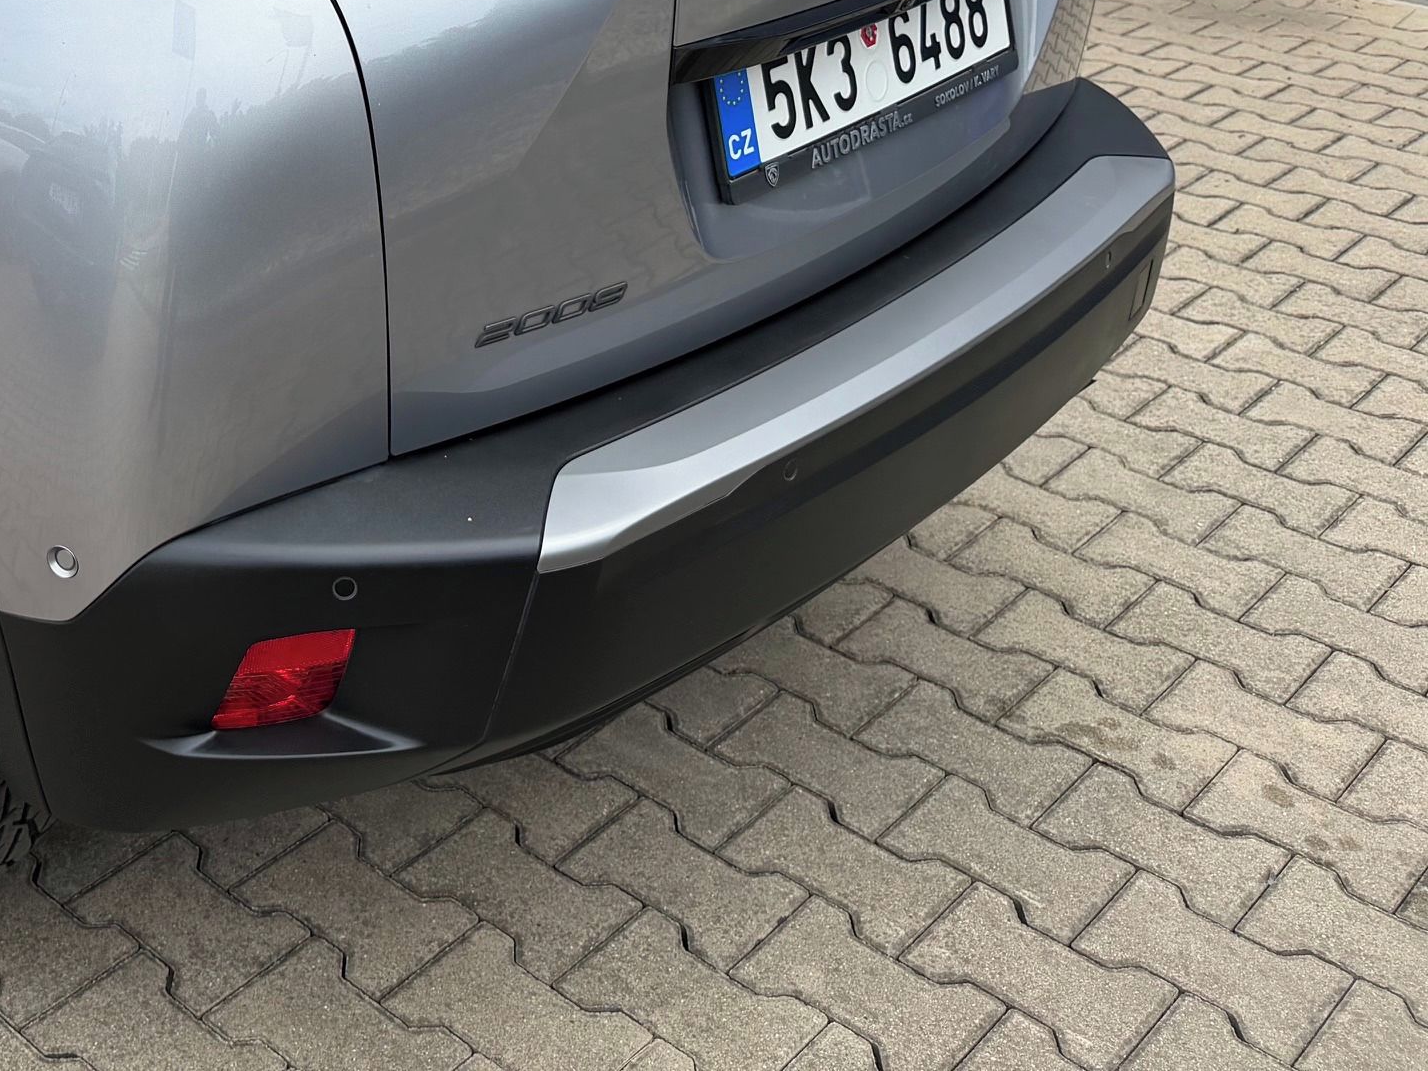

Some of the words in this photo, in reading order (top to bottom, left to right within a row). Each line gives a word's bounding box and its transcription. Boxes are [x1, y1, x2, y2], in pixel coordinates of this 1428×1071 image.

[760, 33, 859, 140] 5K3
[935, 80, 970, 107] SOKOLOV
[727, 127, 755, 161] CZ
[811, 110, 914, 169] AUTODRASTA.cz
[475, 281, 628, 349] 2008
